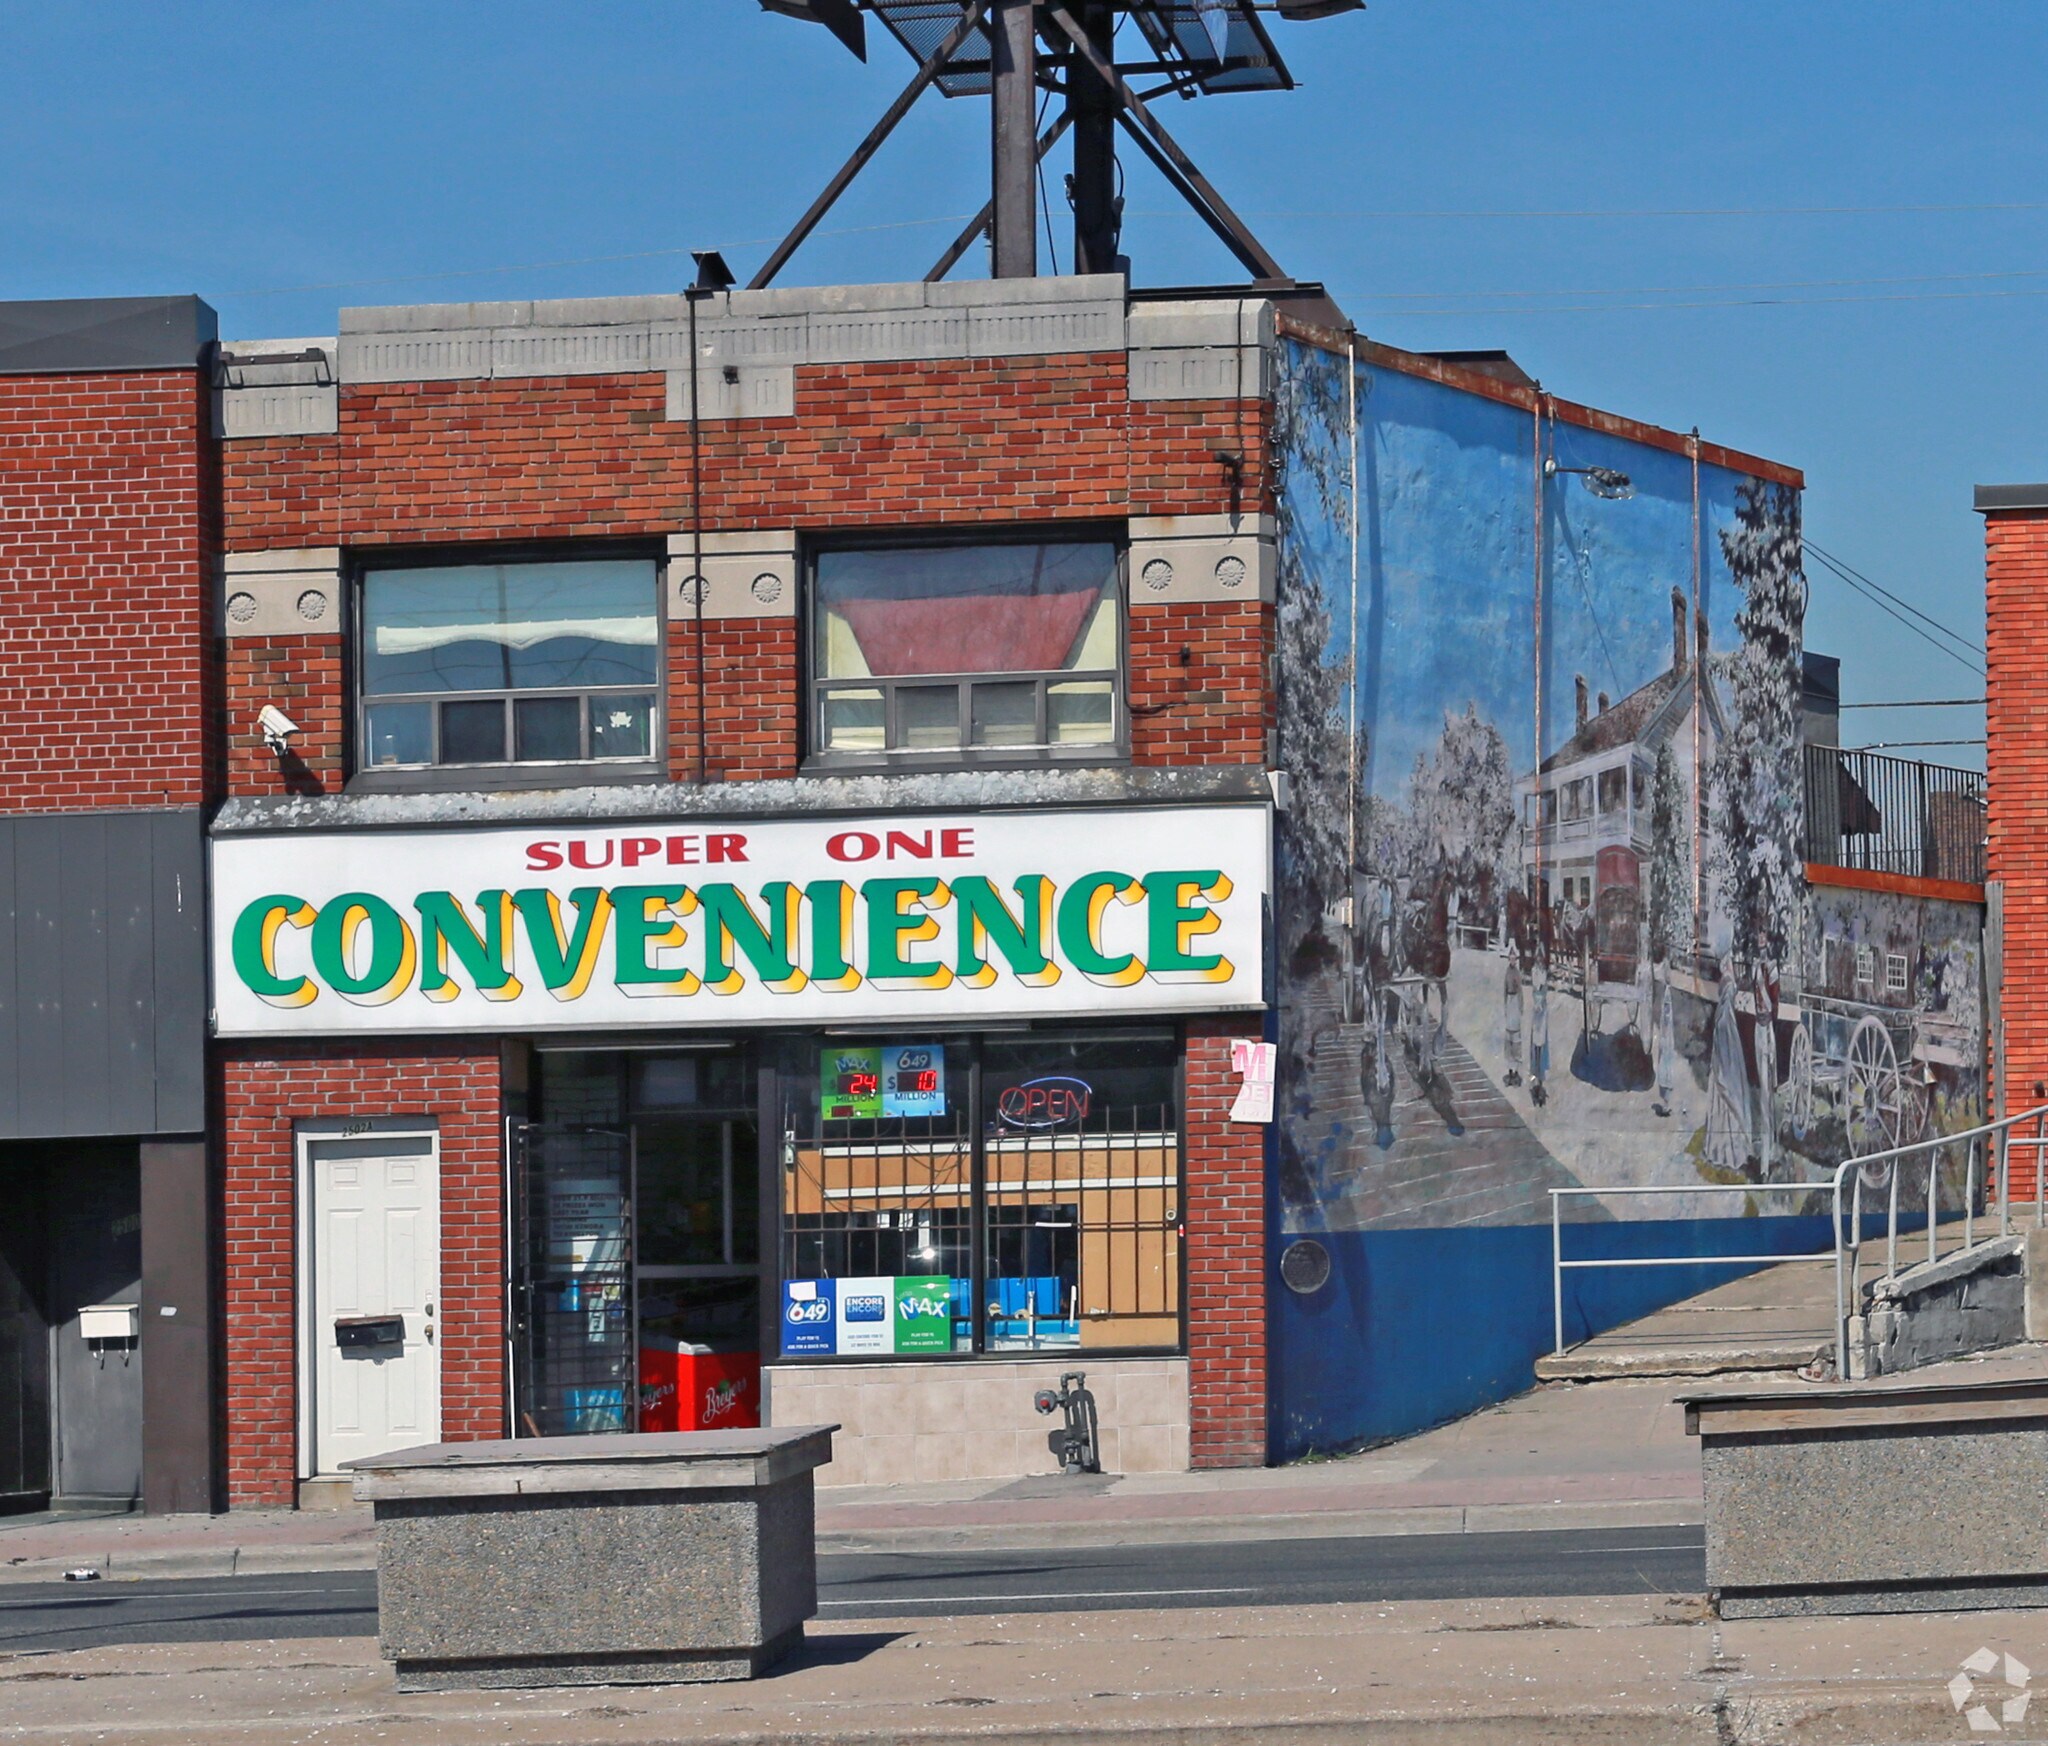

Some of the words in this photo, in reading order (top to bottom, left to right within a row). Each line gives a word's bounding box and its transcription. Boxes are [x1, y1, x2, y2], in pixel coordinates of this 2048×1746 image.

[526, 833, 750, 871] SUPER
[826, 828, 975, 862] ONE
[231, 870, 1235, 1009] CONVENIENCE
[834, 1057, 869, 1072] MAX
[899, 1051, 928, 1068] 649
[850, 1073, 877, 1094] 24
[918, 1069, 938, 1091] 10
[894, 1091, 936, 1101] MILLION
[1000, 1087, 1088, 1118] OPEN
[342, 1120, 373, 1138] 2502A
[789, 1300, 828, 1321] 649
[846, 1296, 883, 1306] ENCORE
[899, 1297, 946, 1321] MAX
